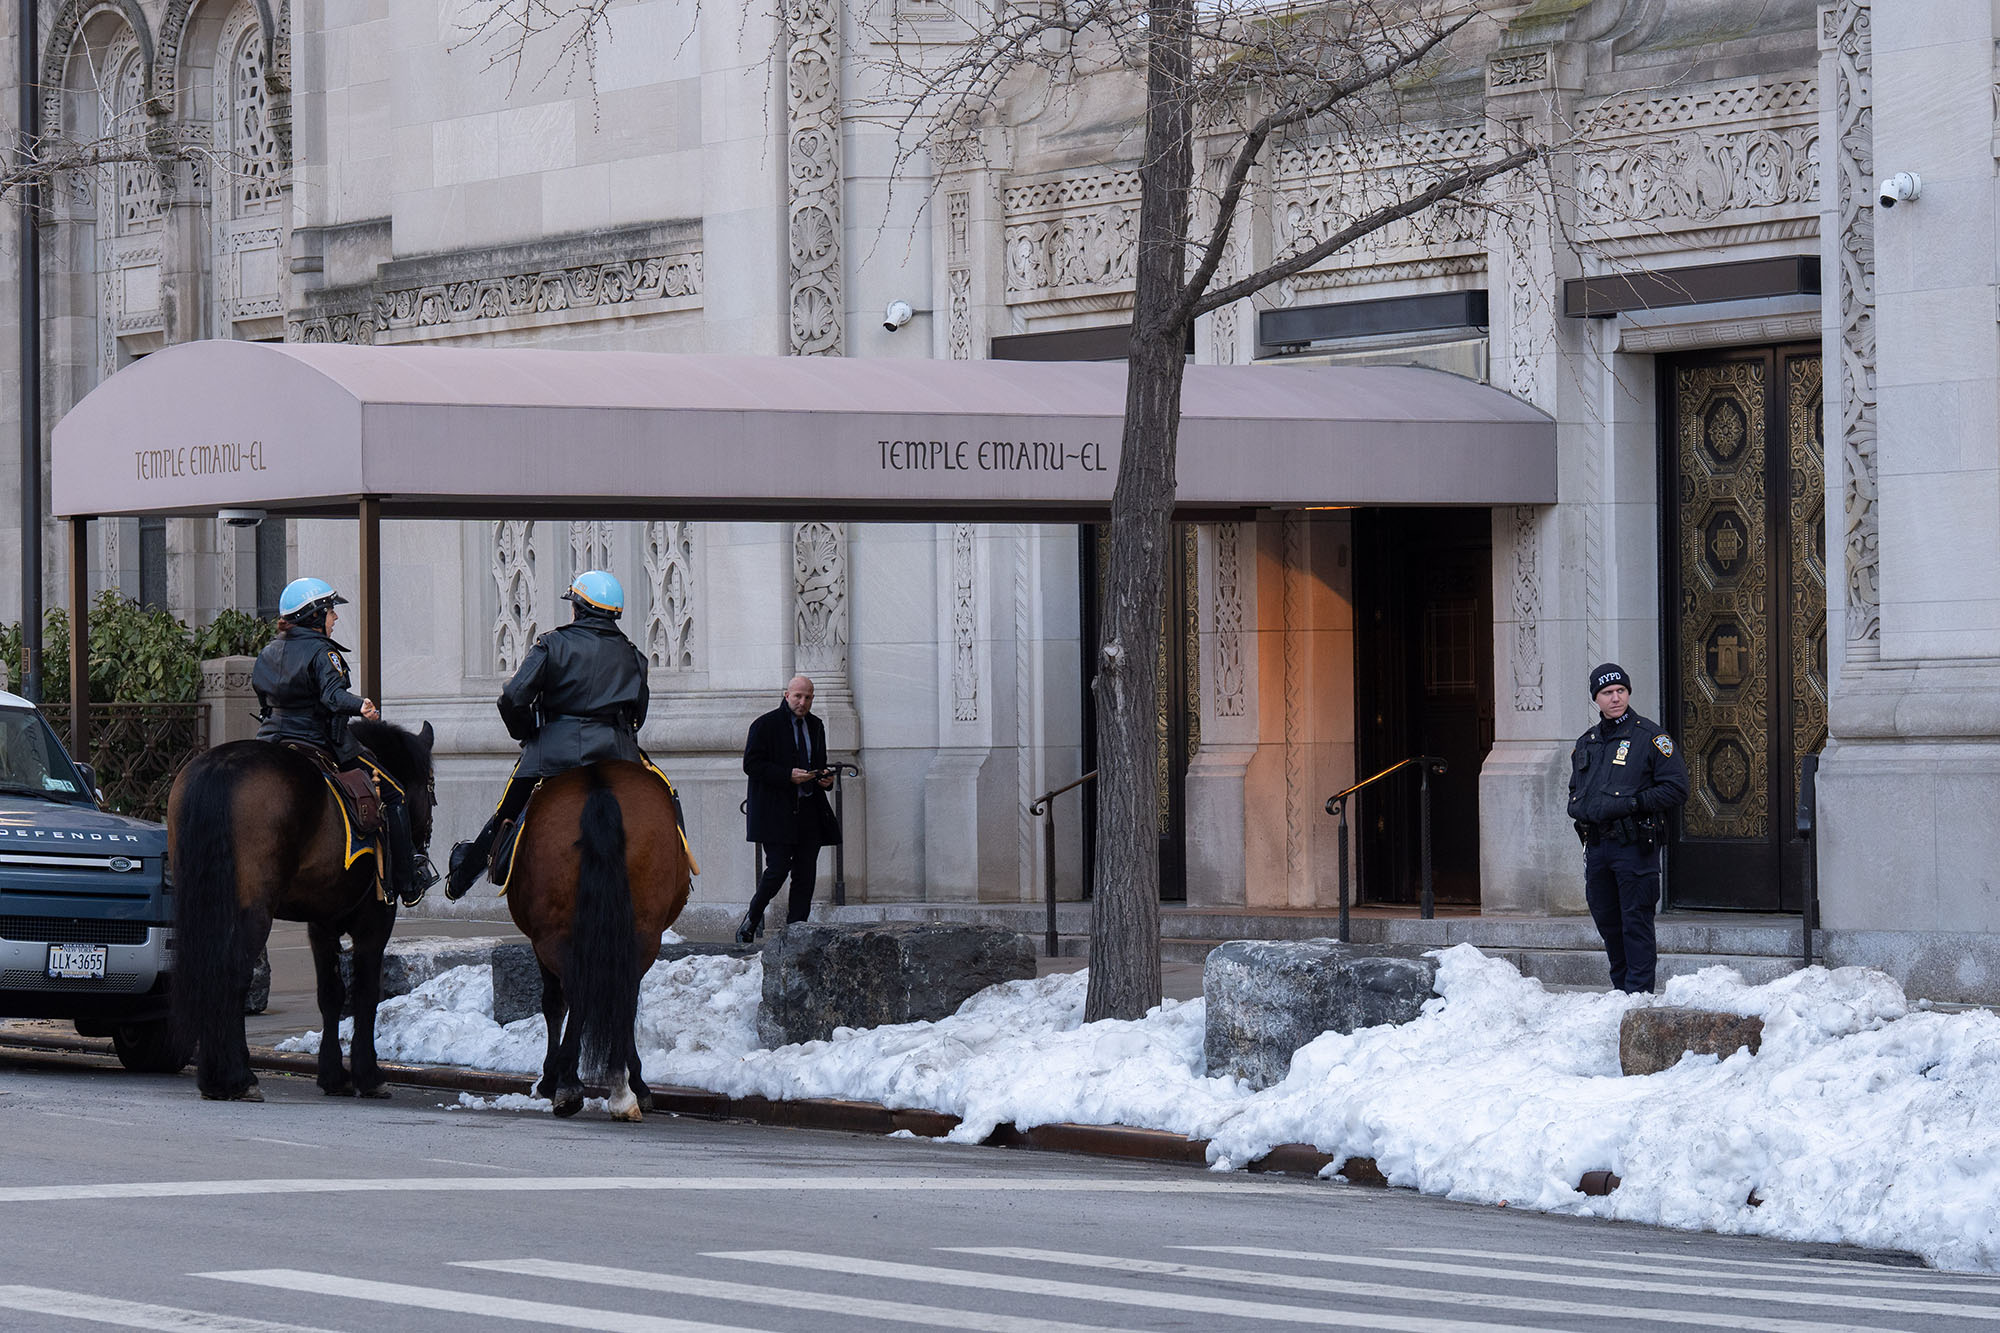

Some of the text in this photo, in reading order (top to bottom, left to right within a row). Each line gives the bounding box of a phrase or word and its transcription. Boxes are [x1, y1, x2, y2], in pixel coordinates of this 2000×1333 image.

[135, 447, 186, 480] TEMPLE
[878, 440, 969, 470] TEMPLE
[1598, 672, 1621, 685] NYPD
[0, 829, 138, 841] DEFENDER
